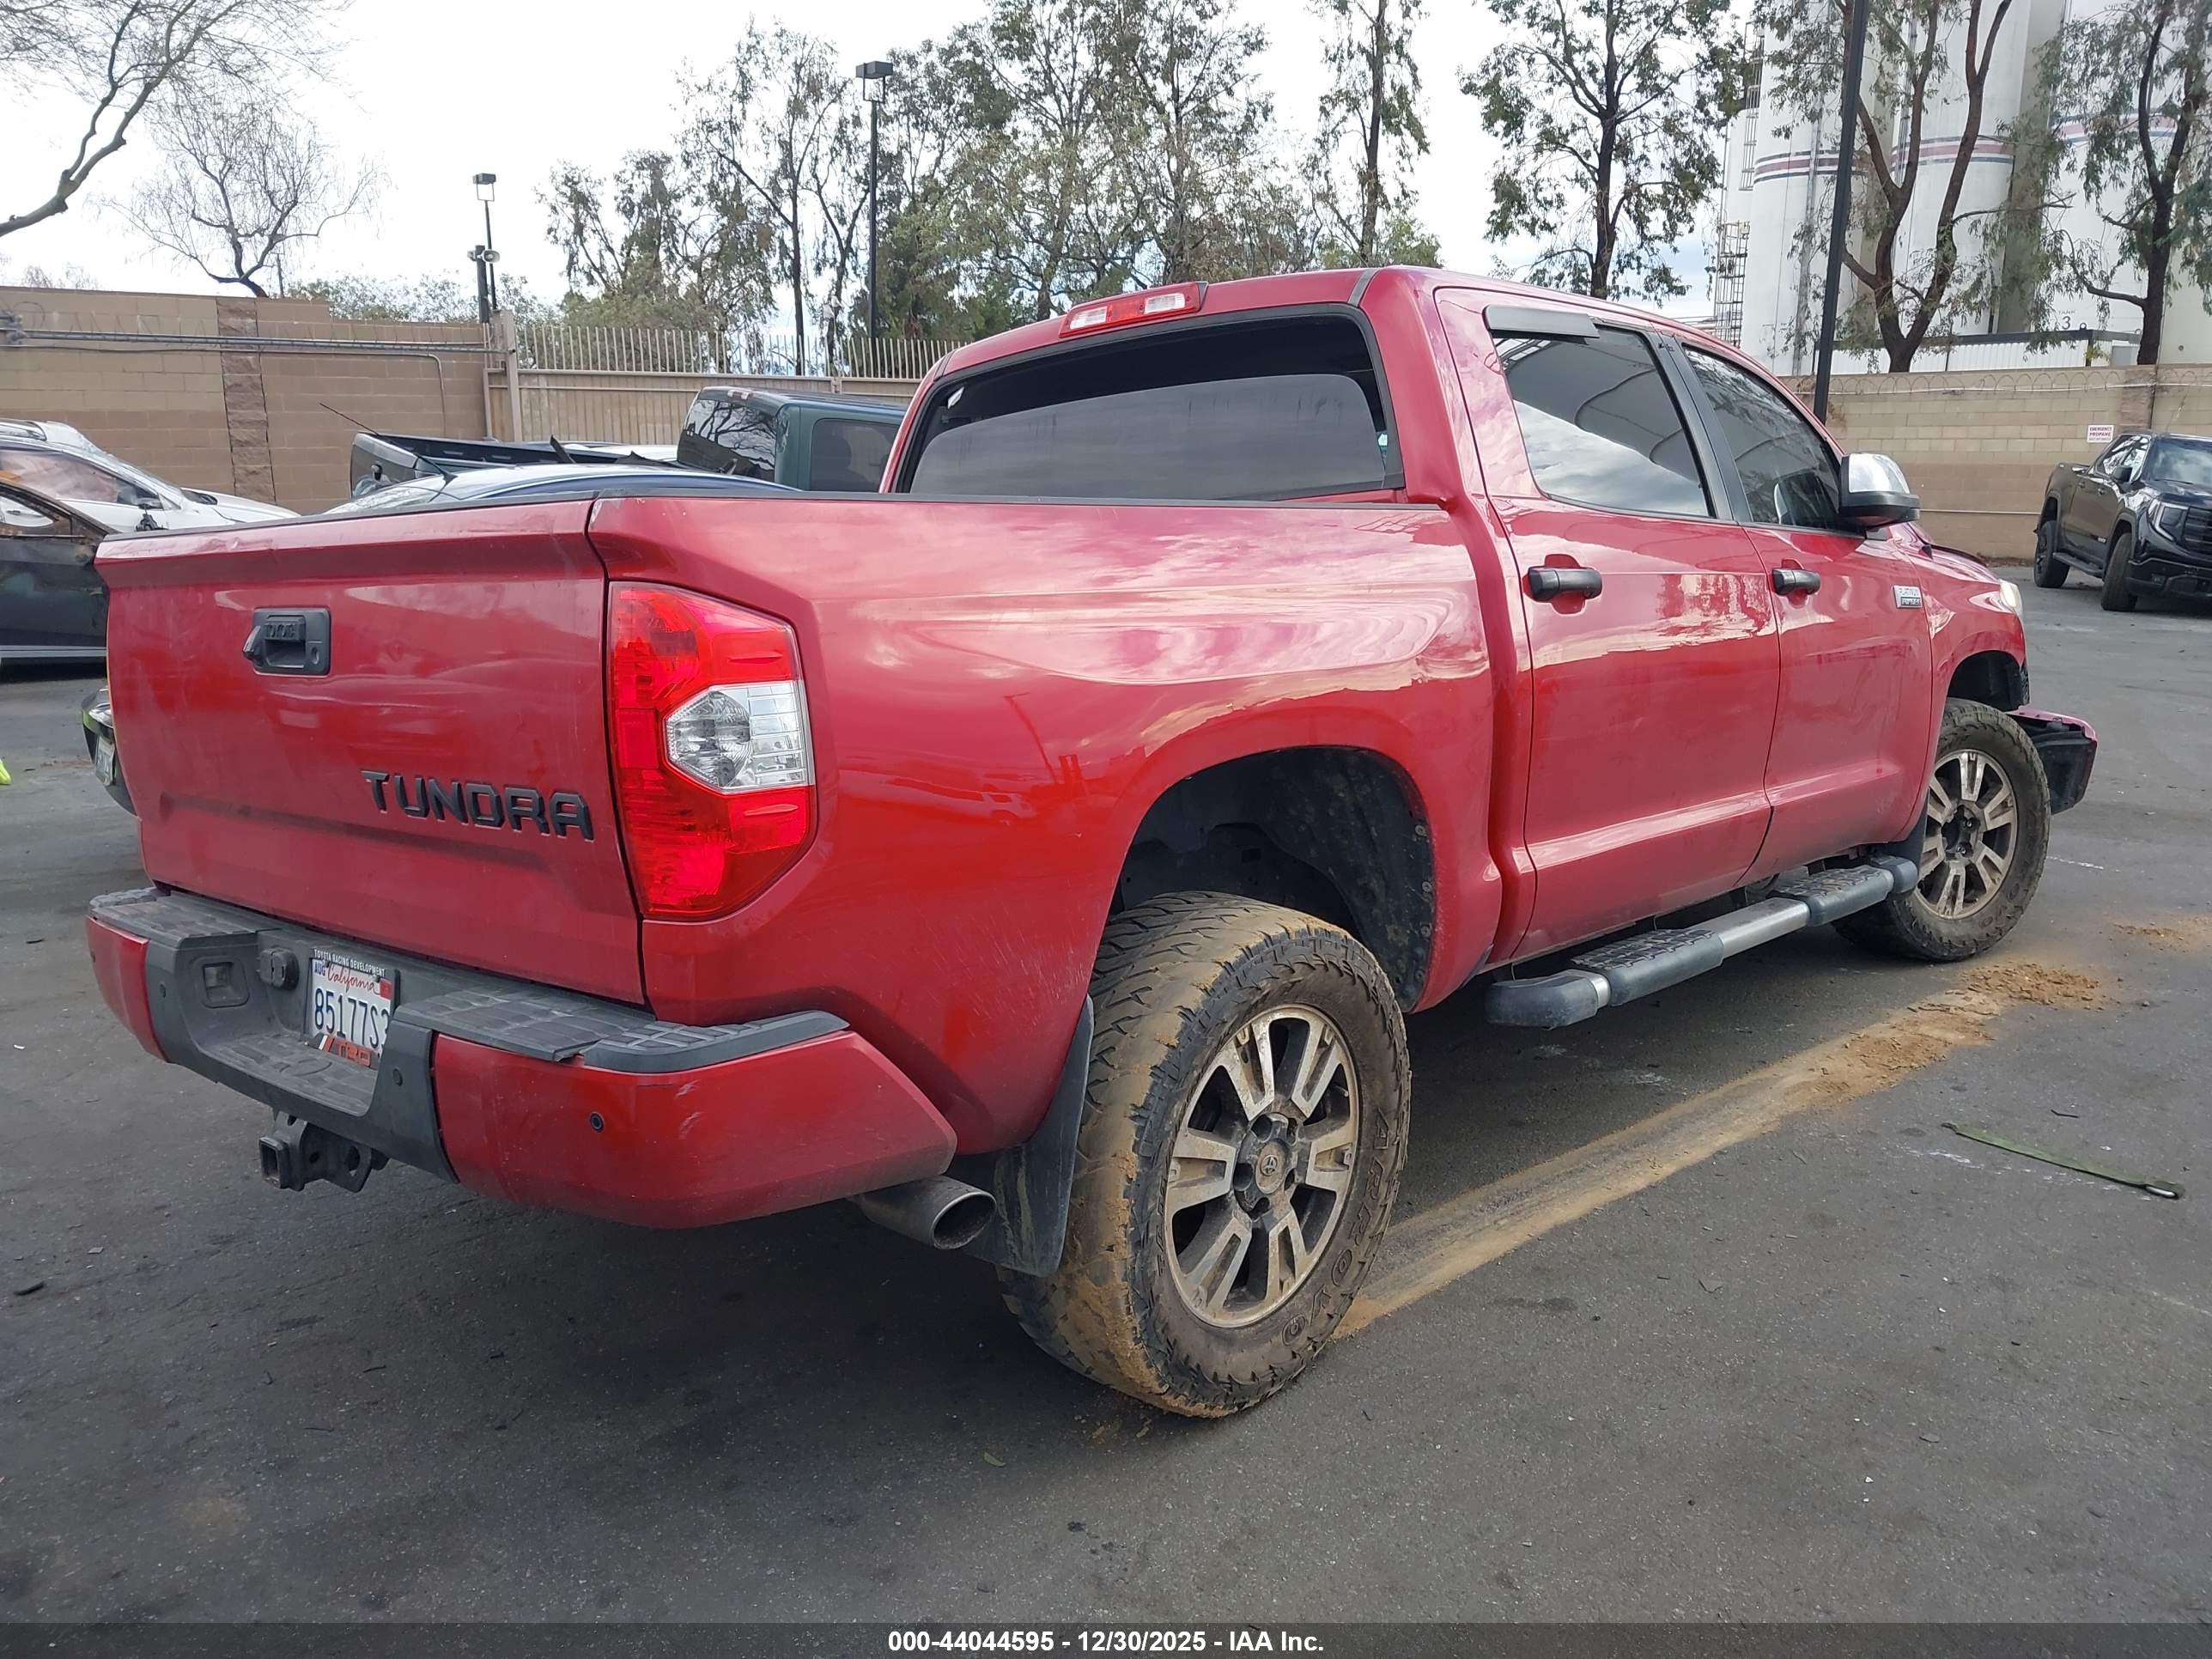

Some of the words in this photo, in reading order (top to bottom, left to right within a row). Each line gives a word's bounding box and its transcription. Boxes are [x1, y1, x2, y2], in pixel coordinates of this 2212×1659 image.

[2062, 315, 2071, 330] 3
[360, 769, 595, 843] TUNDRA
[313, 949, 331, 962] TOYOTA
[332, 953, 350, 965] RACING
[350, 958, 386, 977] DEVELOPMENT
[314, 962, 325, 976] AUG
[327, 963, 380, 994] California
